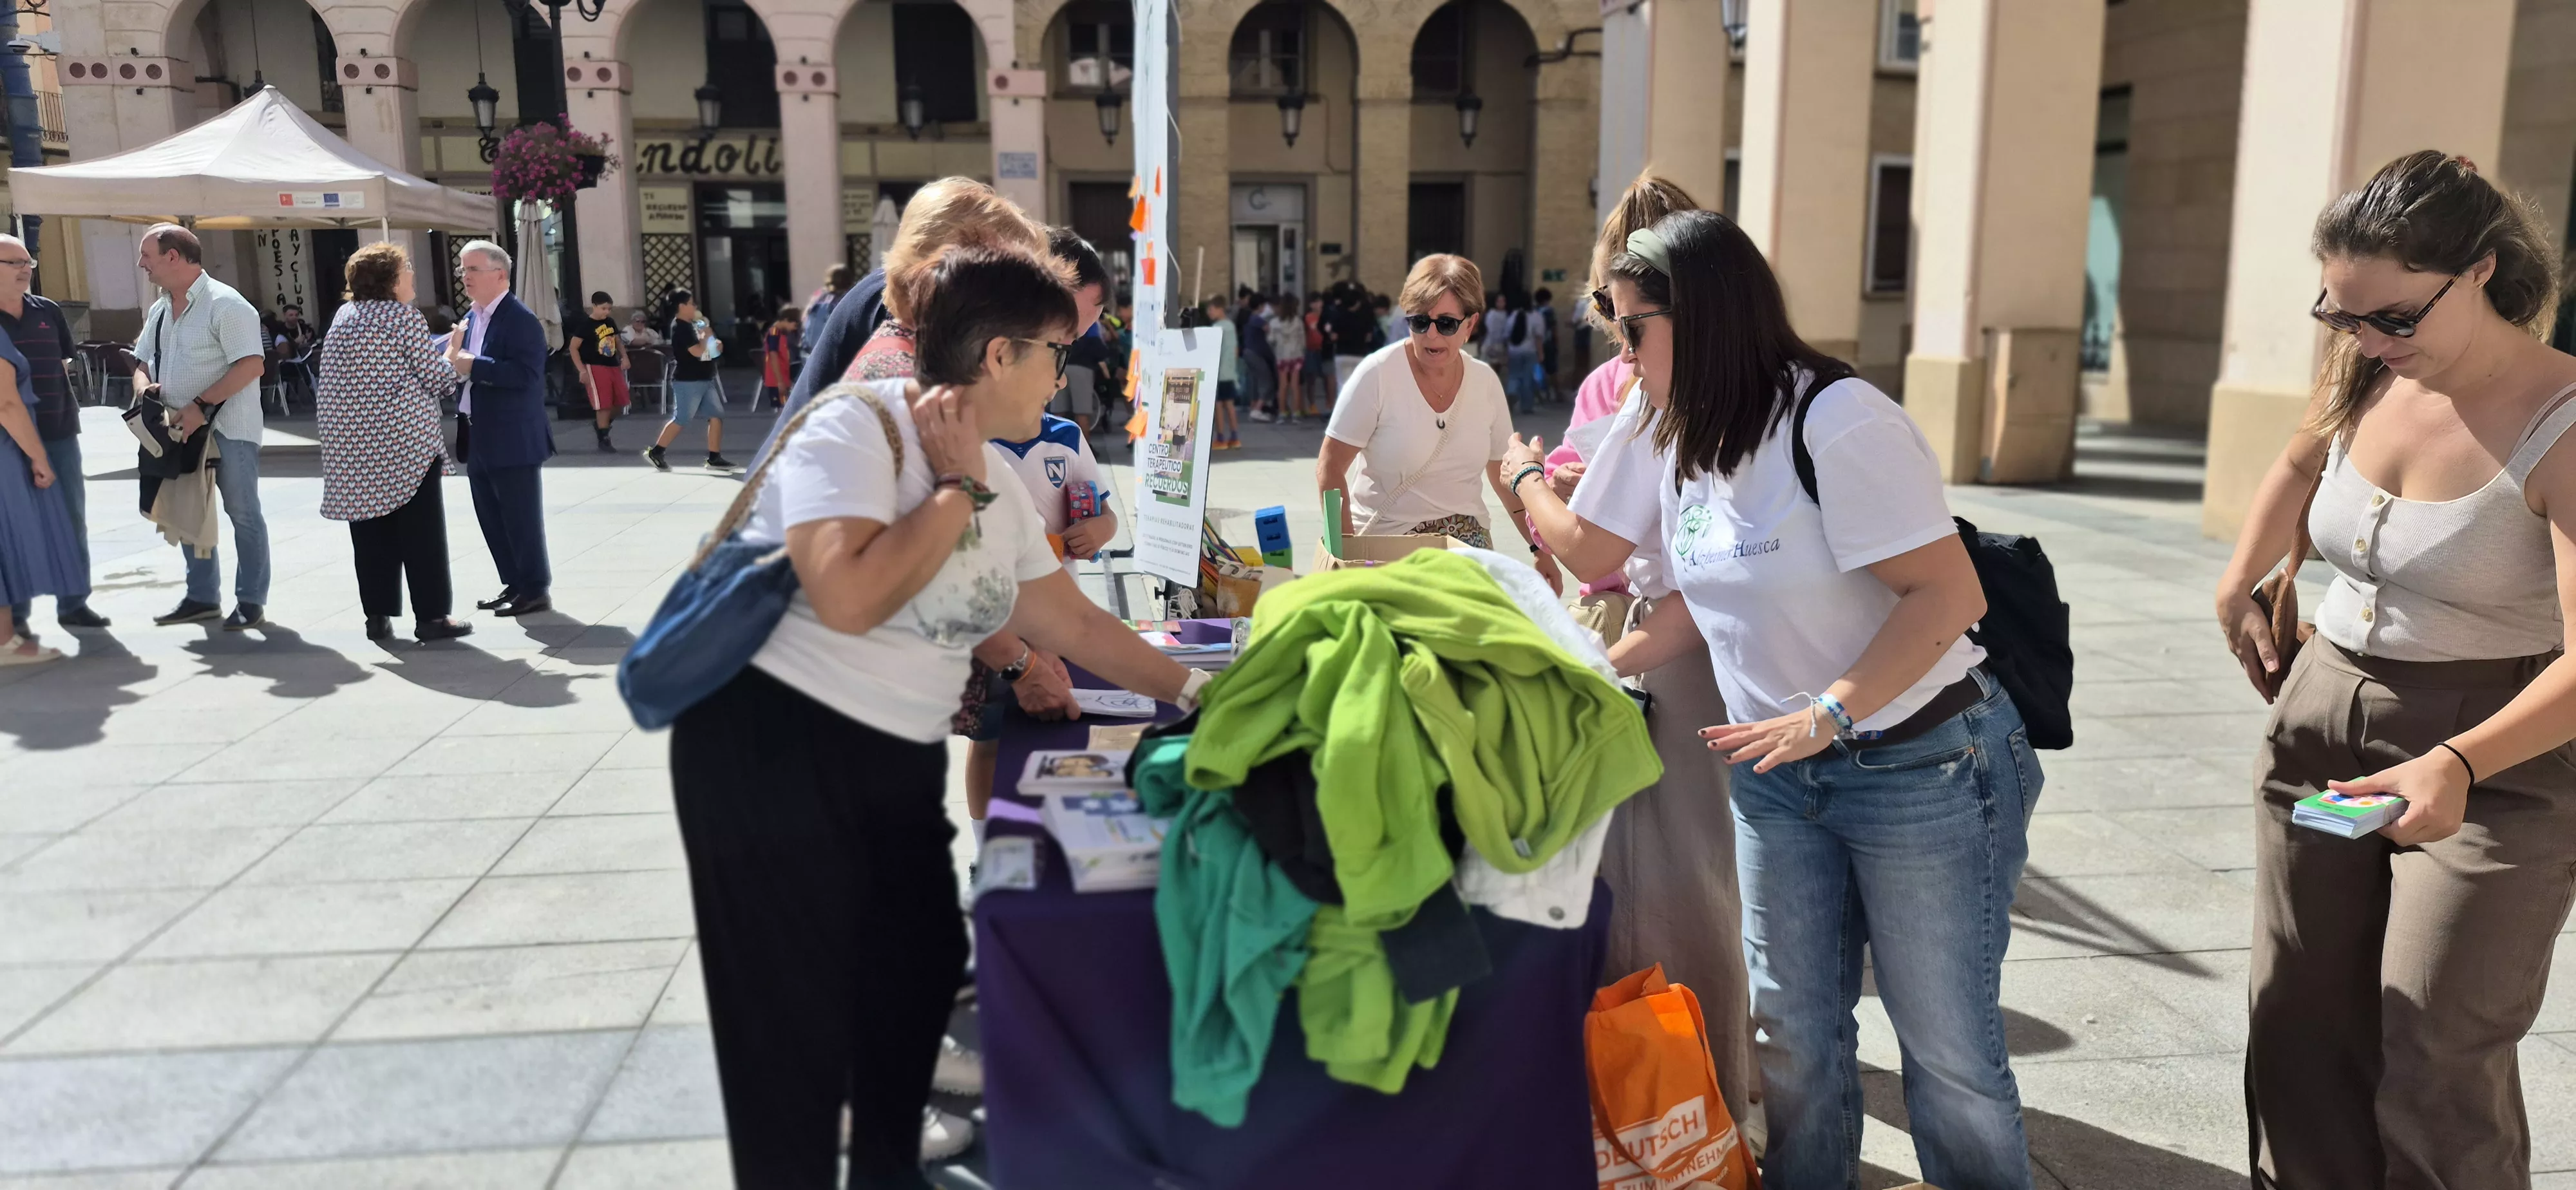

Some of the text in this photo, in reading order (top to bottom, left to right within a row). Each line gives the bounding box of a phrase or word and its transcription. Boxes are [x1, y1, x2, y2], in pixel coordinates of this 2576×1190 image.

[635, 134, 781, 175] ndoli
[1148, 443, 1169, 456] CENTRO
[1145, 473, 1188, 494] RECUERDOS
[1732, 538, 1780, 558] Huesca
